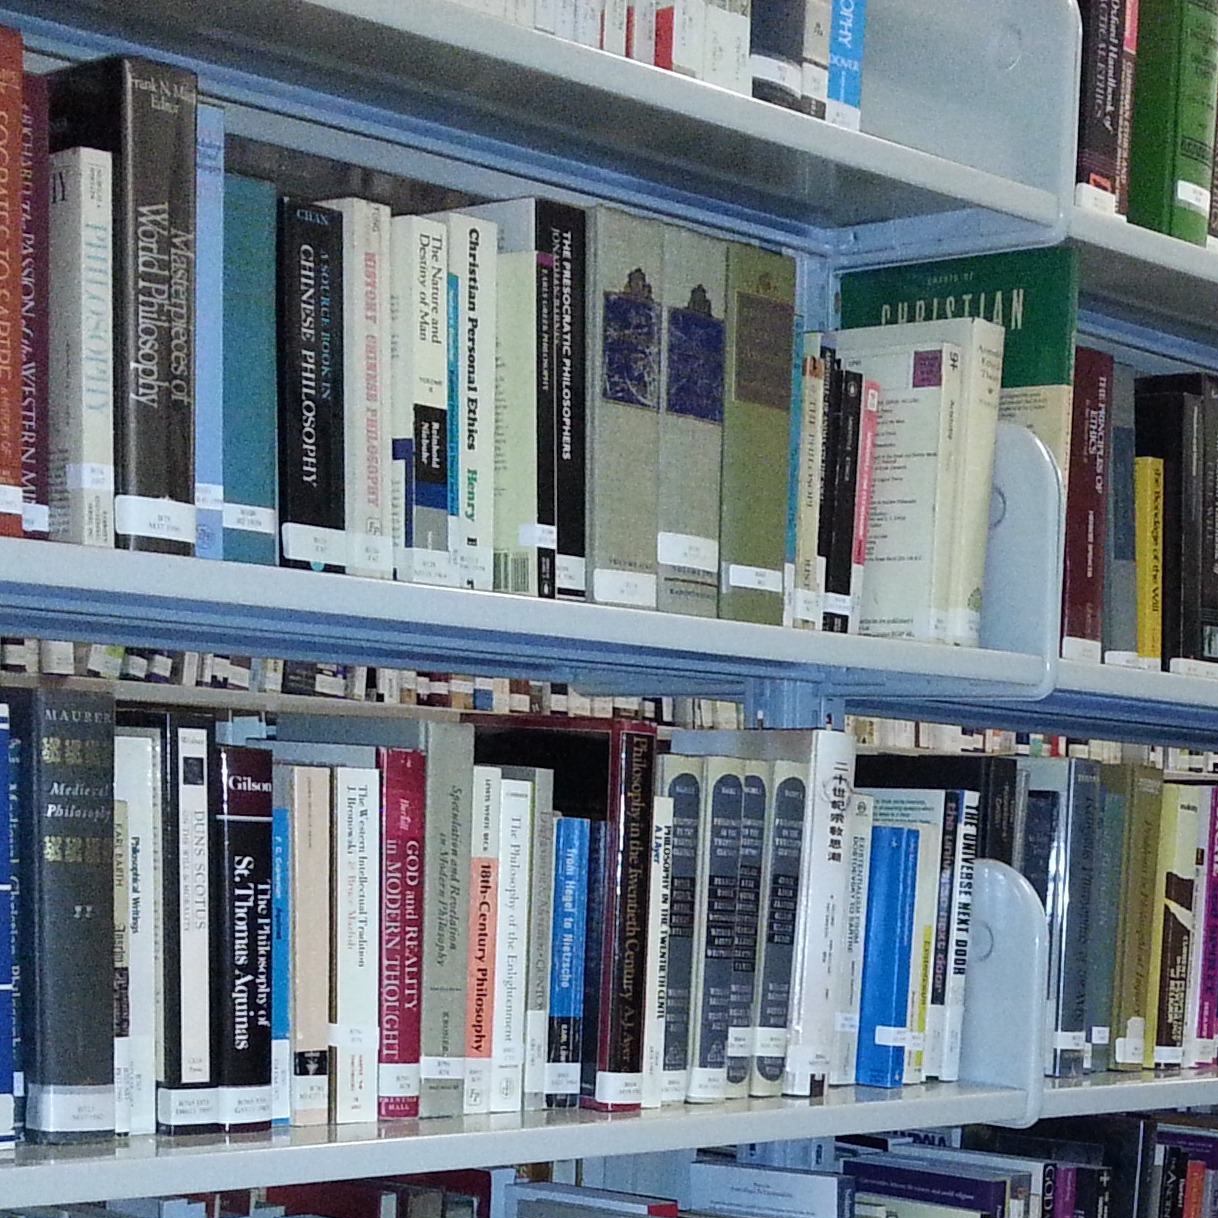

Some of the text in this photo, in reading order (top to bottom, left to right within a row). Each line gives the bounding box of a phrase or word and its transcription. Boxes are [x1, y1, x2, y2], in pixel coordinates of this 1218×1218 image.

[83, 222, 109, 414] PHILOSOPHY
[130, 200, 171, 409] World Philosophy
[170, 225, 195, 405] Masterpieces of
[299, 243, 318, 488] CHINESE PHILOSOPHY
[418, 233, 431, 341] Destiny of Man
[430, 234, 443, 345] The Nature and
[466, 227, 480, 451] Christian Personal Ethics
[561, 231, 573, 461] THE PRESOCRATIC PHILOSOPHERS
[464, 468, 478, 522] Henry
[194, 808, 207, 928] DUNS SCOTUS
[228, 773, 272, 793] Gilson
[357, 806, 369, 854] Western
[358, 785, 369, 806] The
[620, 736, 648, 1002] Philosophy in the Twentieth Century
[826, 761, 851, 864] 二十世紀宗教思潮
[130, 836, 142, 935] Philosophical Writings
[231, 855, 254, 1052] St. Thomas Aquinas
[254, 879, 272, 1027] The Philosophy of
[356, 857, 369, 914] Intellectual
[356, 916, 369, 968] Tradition
[382, 839, 401, 1061] in MODERN THOUGHT
[403, 840, 420, 1012] GOD and REALITY
[471, 863, 493, 1053] 18th-Century Philosophy
[502, 815, 523, 1042] The Philosophy of the Enlightenment
[952, 803, 979, 976] THE UNIVERSE NEXT DOOR
